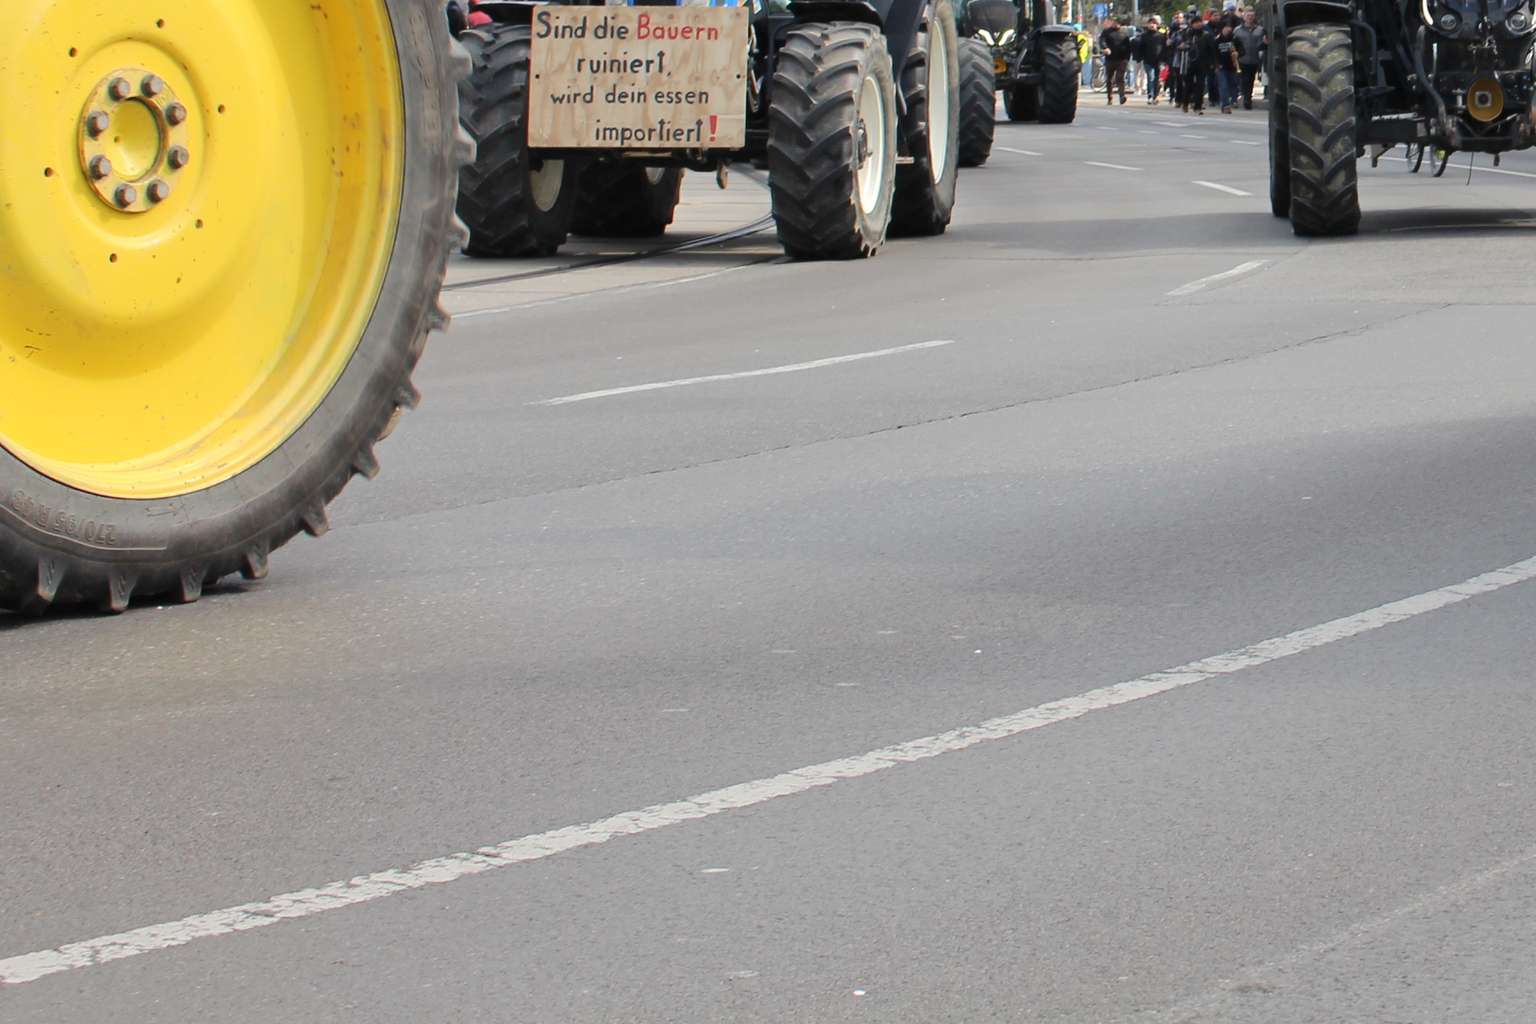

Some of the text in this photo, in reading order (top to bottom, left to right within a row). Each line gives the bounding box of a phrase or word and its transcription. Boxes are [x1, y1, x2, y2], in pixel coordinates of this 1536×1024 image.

[536, 11, 719, 41] Sind die Bauern
[550, 83, 709, 105] wird dein essen
